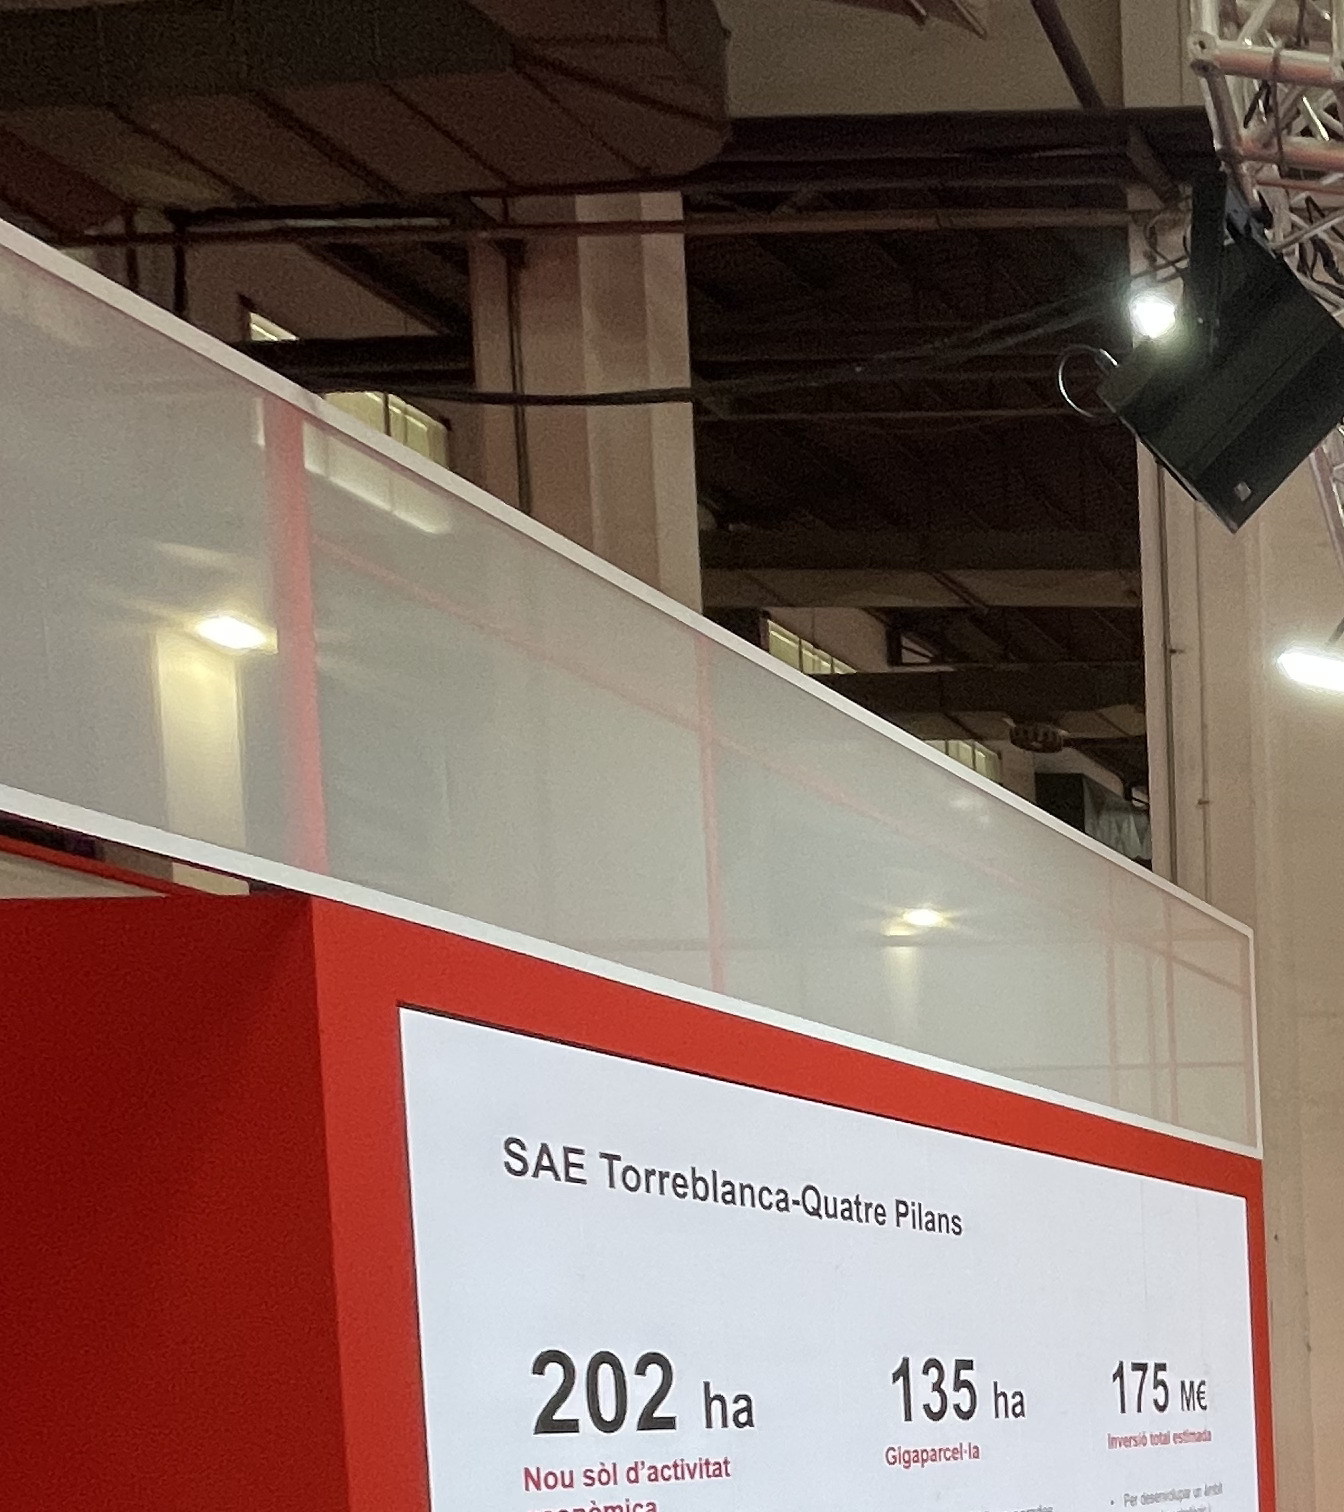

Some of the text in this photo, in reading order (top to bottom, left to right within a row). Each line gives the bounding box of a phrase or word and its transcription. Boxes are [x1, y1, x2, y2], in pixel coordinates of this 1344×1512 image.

[503, 1136, 963, 1237] SAE Torreblanca-Quatre Pilans
[532, 1350, 755, 1435] 202 ha
[890, 1357, 1026, 1423] 135 ha
[1112, 1361, 1208, 1414] 175 M€
[523, 1466, 575, 1491] Nou
[582, 1461, 618, 1488] sòl
[885, 1442, 981, 1469] Gigaparcel·la
